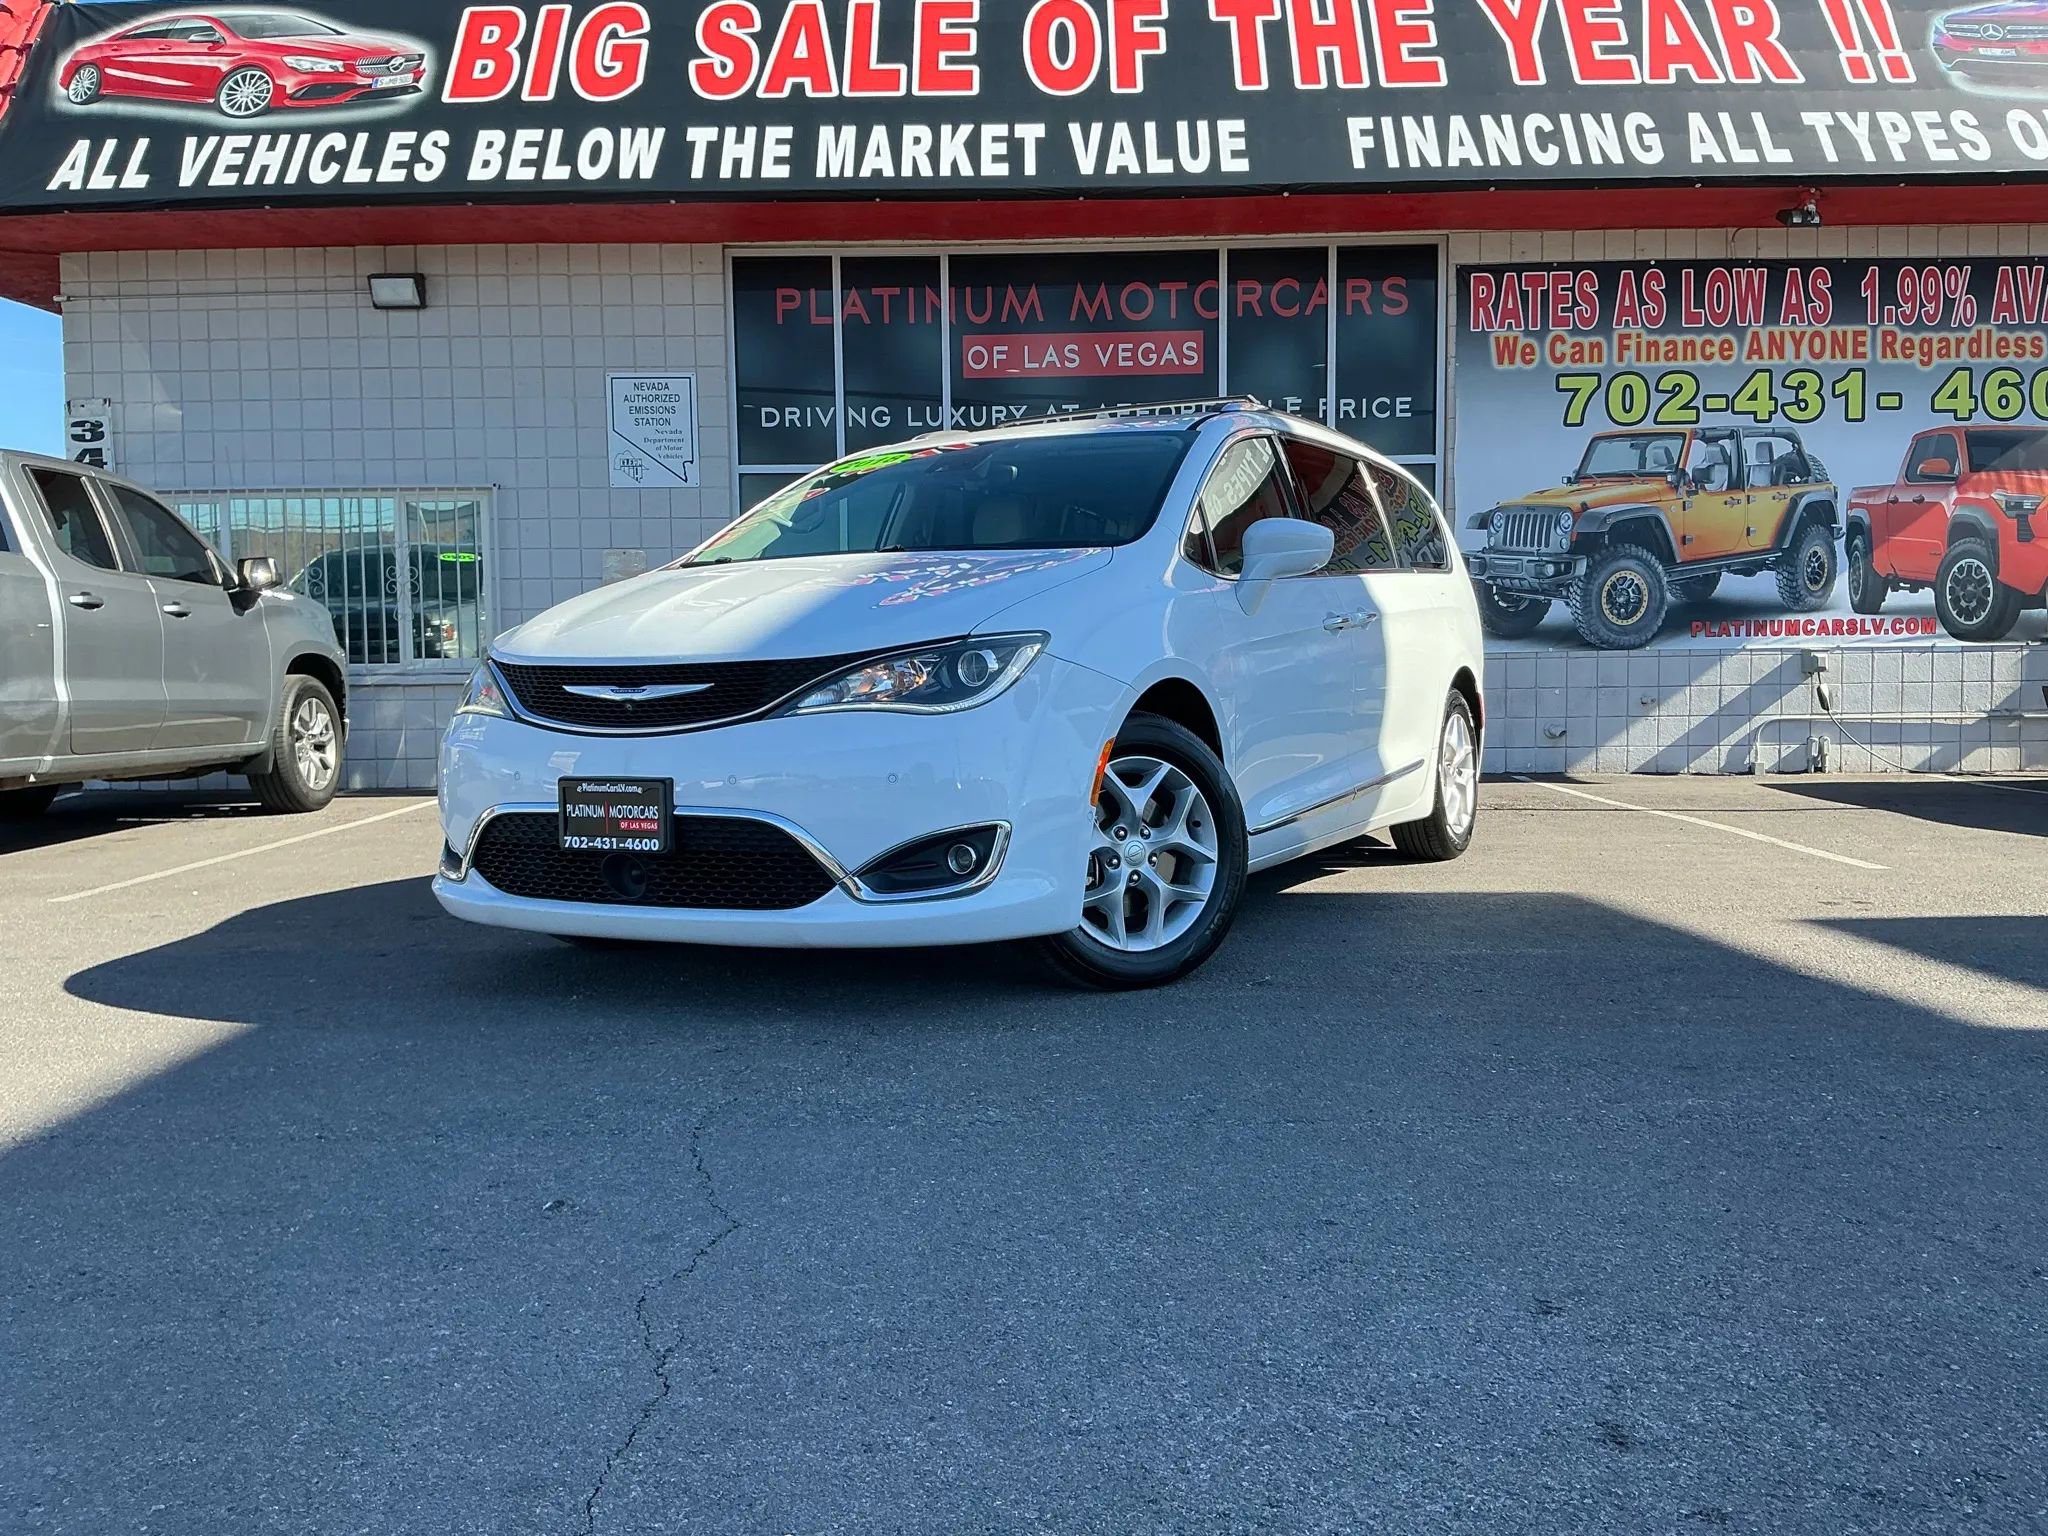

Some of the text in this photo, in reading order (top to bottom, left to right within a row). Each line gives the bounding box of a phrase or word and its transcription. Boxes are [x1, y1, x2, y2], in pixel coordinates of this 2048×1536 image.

[441, 0, 1917, 103] BIG SALE OF THE YEAR !!
[1346, 109, 2048, 169] FINANCING ALL TYPES O
[46, 119, 1251, 191] ALL VEHICLES BELOW THE MARKET VALUE
[776, 276, 1410, 325] PLATINUM MOTORCARS
[1469, 265, 2048, 332] RATES AS LOW AS 1.99% AV
[967, 341, 1200, 370] OF LAS VEGAS
[1493, 328, 2044, 367] We Can Finance ANYONE Regardless
[633, 382, 670, 391] NEVADA
[623, 393, 681, 403] AUTHORIZED
[628, 405, 677, 415] EMISSIONS
[761, 405, 891, 428] DRIVNG
[907, 405, 1027, 427] LUXURY
[1318, 396, 1412, 419] PRICE
[634, 417, 671, 427] STATION
[643, 437, 685, 445] Department
[658, 452, 684, 460] Vehicles
[1690, 617, 1937, 638] PLATINUMCARSLV.COM
[566, 804, 659, 819] PLATINUM MOTORCARS
[640, 822, 658, 830] VEGAS
[564, 836, 659, 850] 702-431-4600
